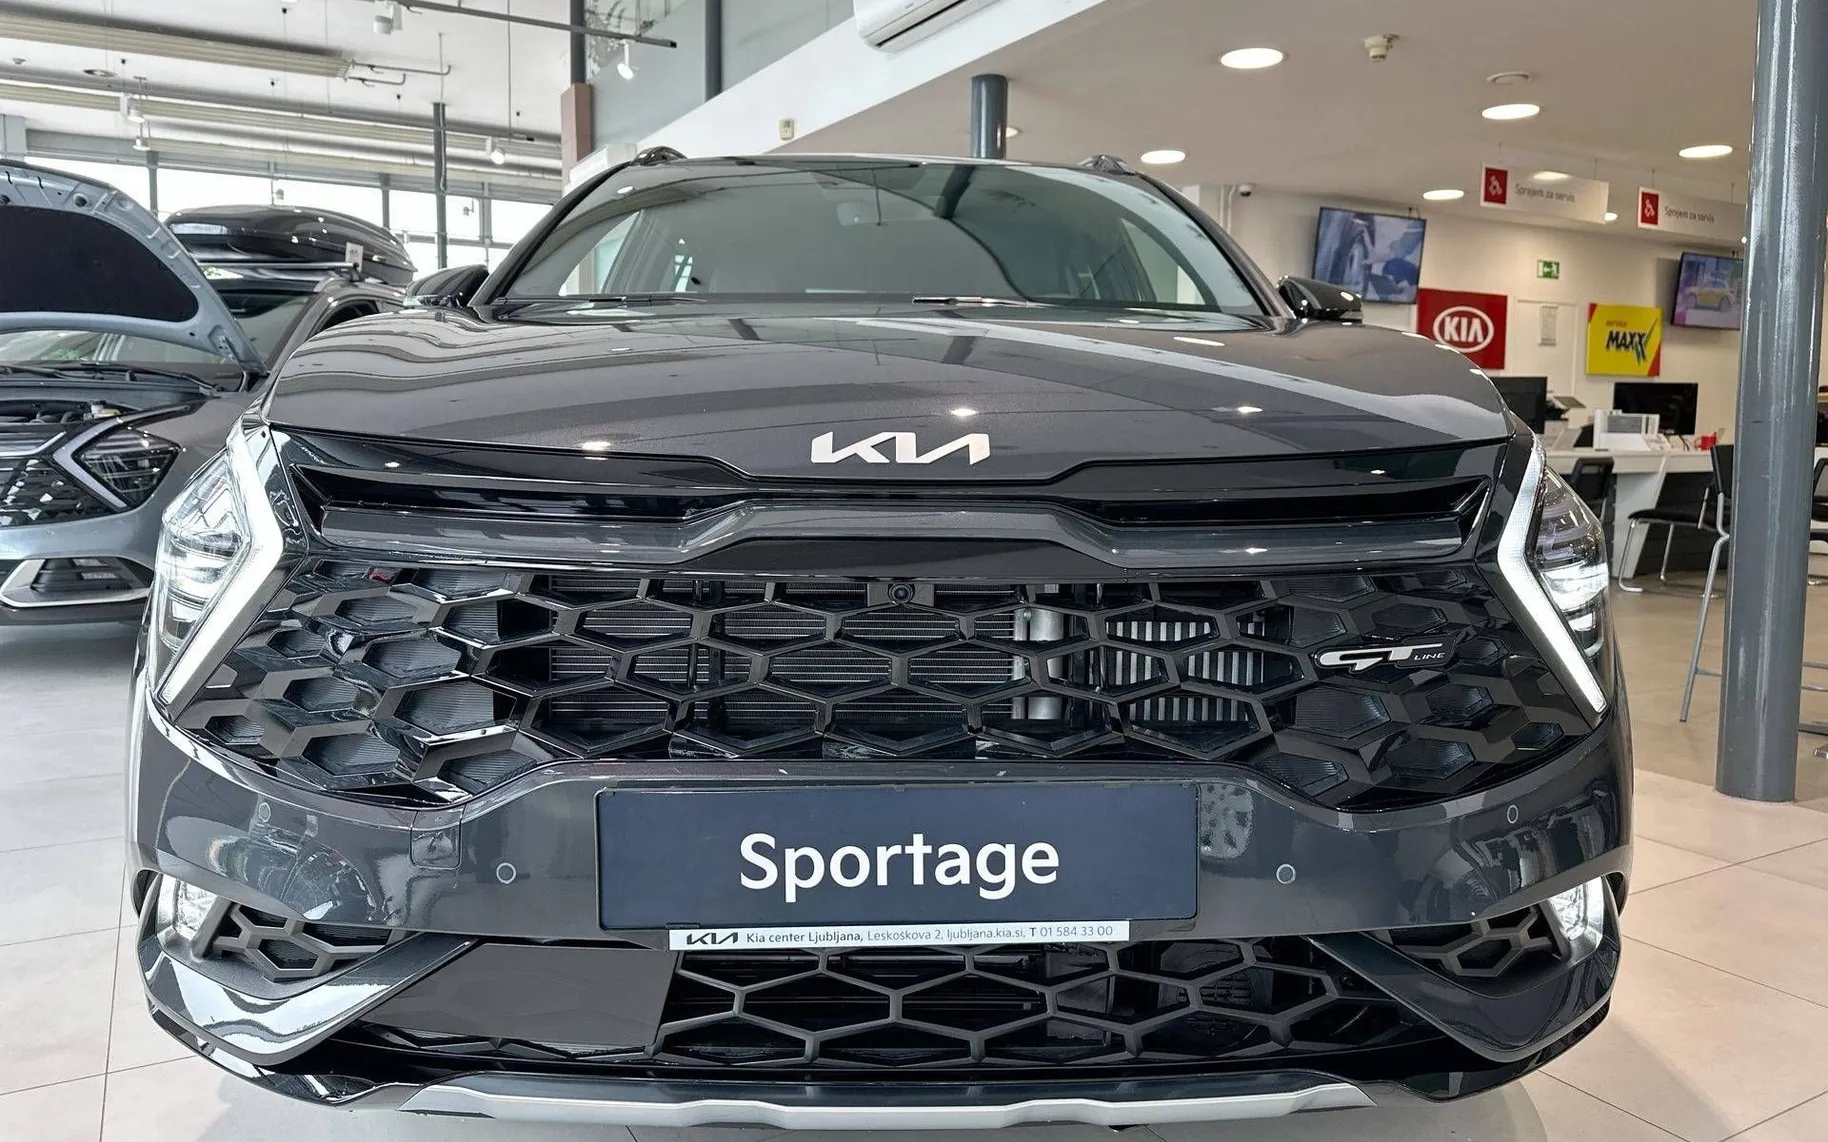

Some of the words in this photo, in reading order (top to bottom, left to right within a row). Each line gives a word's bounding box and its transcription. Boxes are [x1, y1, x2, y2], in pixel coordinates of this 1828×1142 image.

[1443, 315, 1485, 343] KIA
[811, 431, 991, 465] KIA
[1319, 642, 1443, 671] GT
[1413, 652, 1446, 661] LINE
[740, 832, 1060, 903] Sportage
[686, 931, 739, 946] KIA
[746, 932, 766, 943] Kia
[768, 932, 805, 943] center
[808, 931, 864, 945] Ljubljana,
[947, 927, 1026, 942] ljubljana.kia.si,
[1029, 926, 1037, 938] T
[1040, 926, 1053, 938] 01
[1056, 926, 1077, 938] 584
[1080, 926, 1094, 937] 33
[1097, 925, 1113, 937] 00
